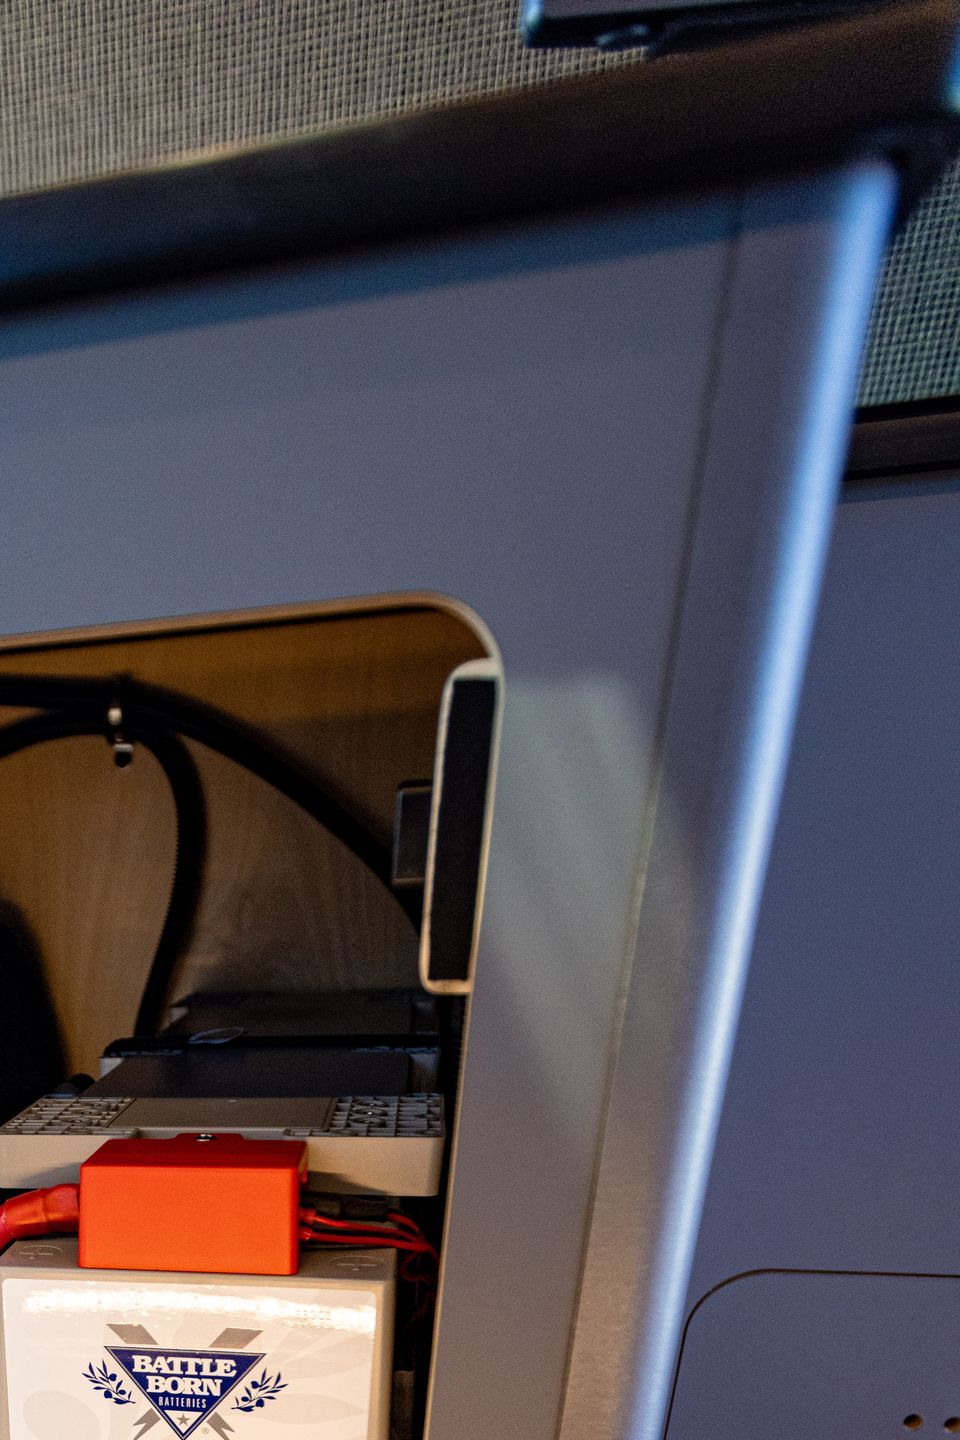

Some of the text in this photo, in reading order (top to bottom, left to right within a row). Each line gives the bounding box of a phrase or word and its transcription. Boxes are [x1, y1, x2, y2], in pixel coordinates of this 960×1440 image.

[132, 1355, 237, 1377] BATTLE
[146, 1375, 222, 1396] BORN
[158, 1396, 207, 1409] BATTERIES
